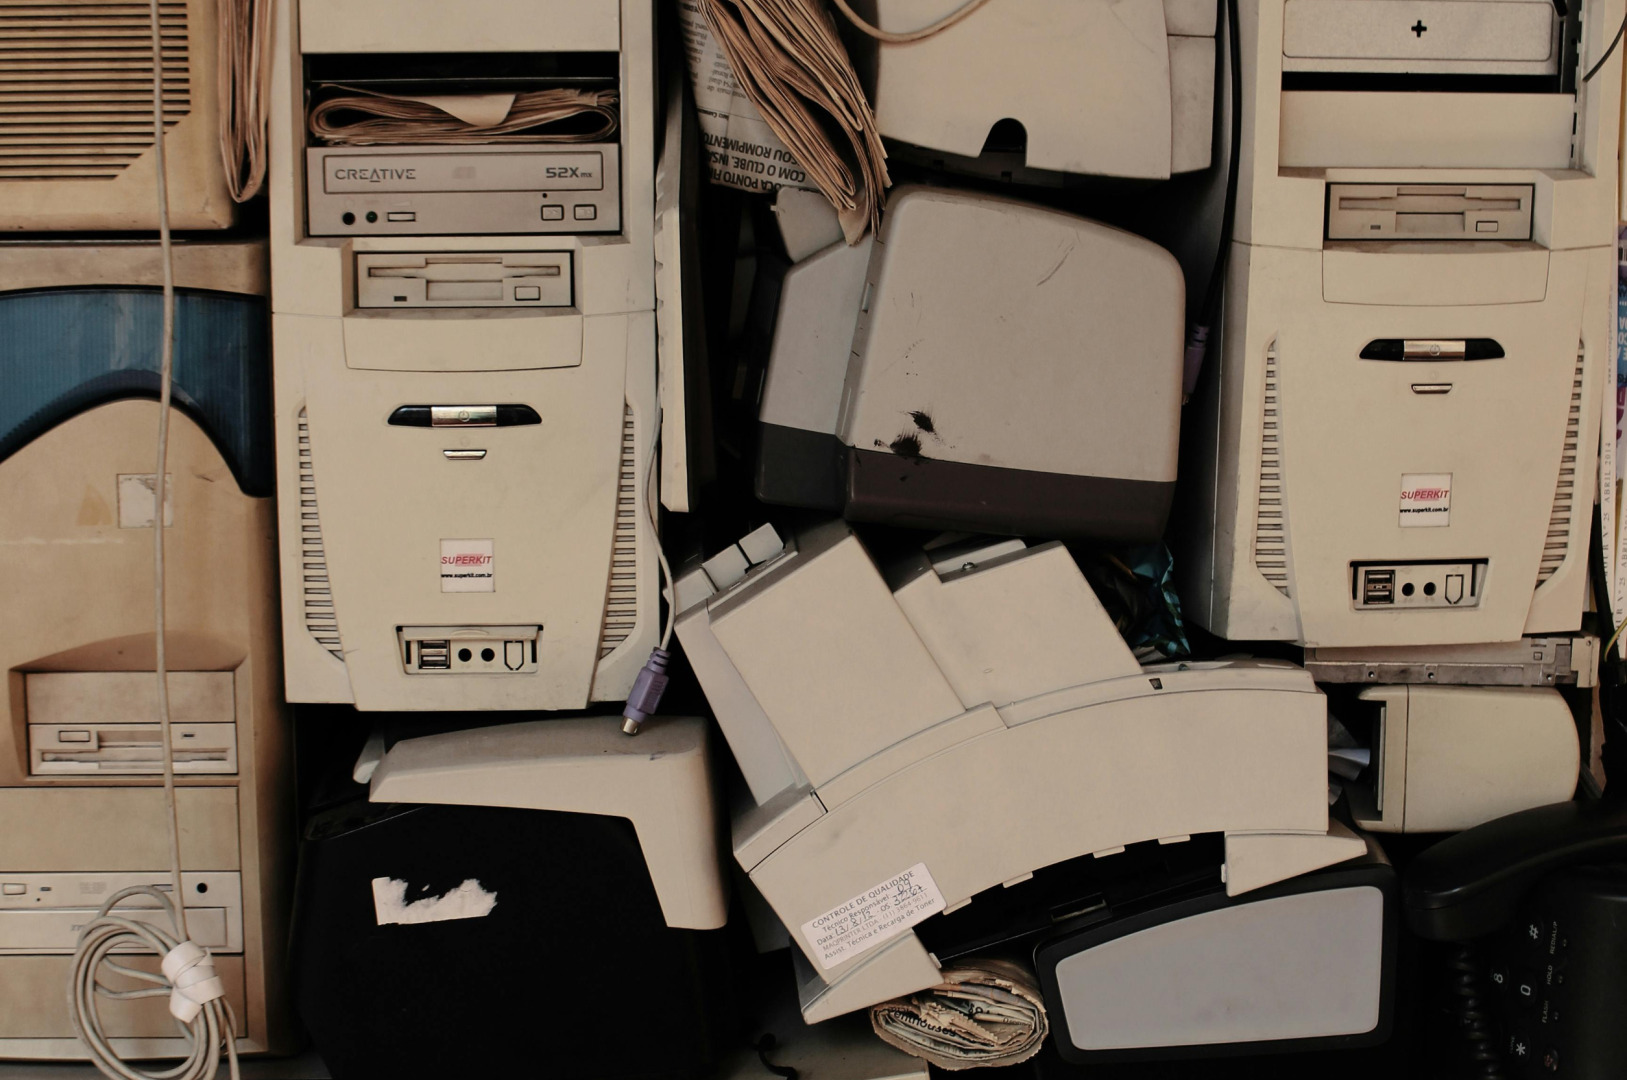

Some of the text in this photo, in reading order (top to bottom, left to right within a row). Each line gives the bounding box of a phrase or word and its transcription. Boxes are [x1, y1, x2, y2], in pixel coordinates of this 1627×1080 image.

[773, 149, 800, 166] SOU
[335, 168, 416, 182] CREATIVE
[707, 151, 806, 183] COM O CLUBE. INSA
[723, 171, 758, 189] PONTO
[761, 179, 782, 192] OCA
[1400, 489, 1450, 500] SUPERKIT
[441, 555, 493, 565] SUPERKIT
[812, 870, 915, 929] CONTROLE DE QUALIDADE
[823, 916, 849, 933] Técnico
[847, 931, 873, 948] Técnica
[878, 915, 906, 932] Recarga
[906, 909, 915, 917] de
[915, 898, 935, 912] Toner
[1493, 973, 1503, 984] 8
